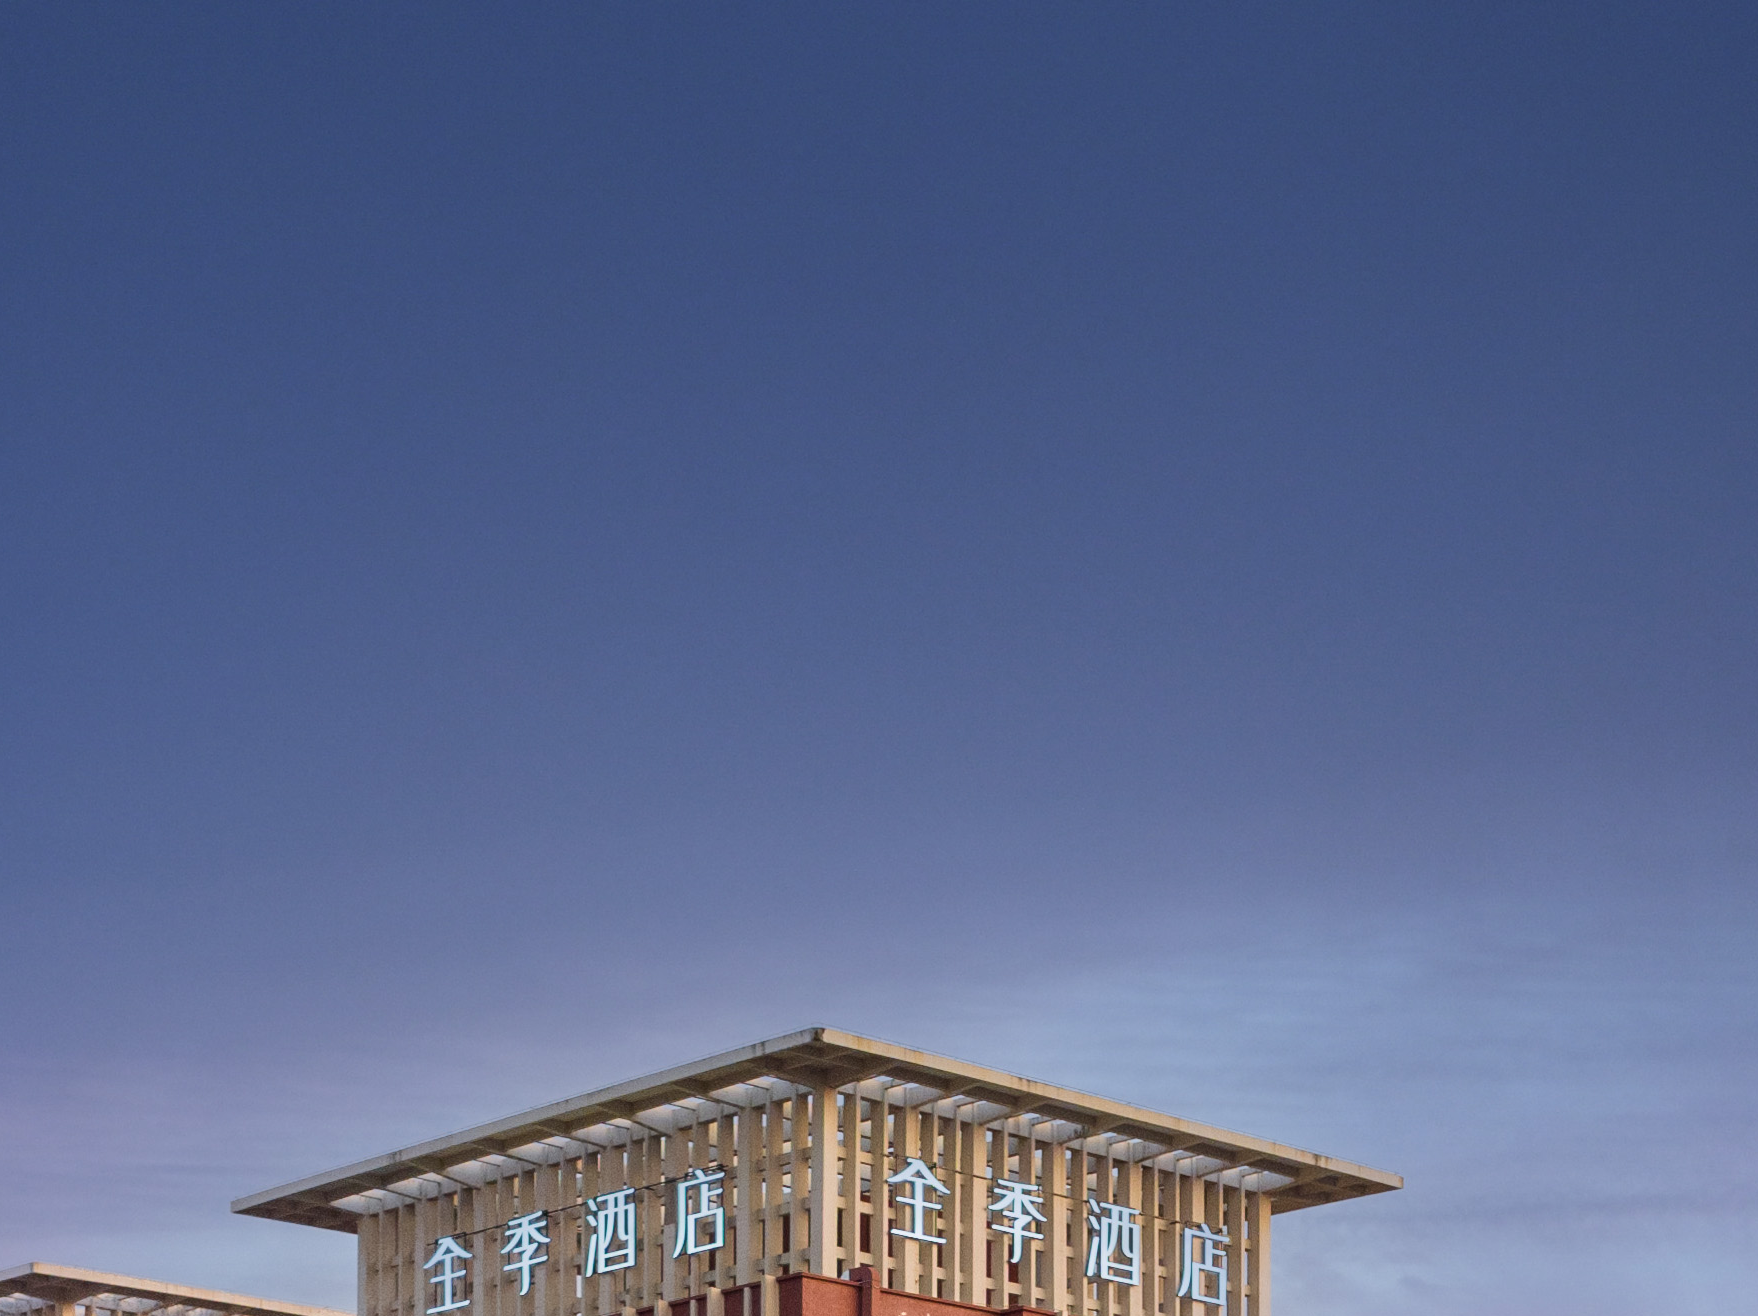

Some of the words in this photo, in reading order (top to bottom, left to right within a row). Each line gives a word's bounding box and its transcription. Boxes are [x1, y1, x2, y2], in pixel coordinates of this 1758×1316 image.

[424, 1168, 727, 1315] 全季酒店
[887, 1156, 1231, 1307] 全季酒店
